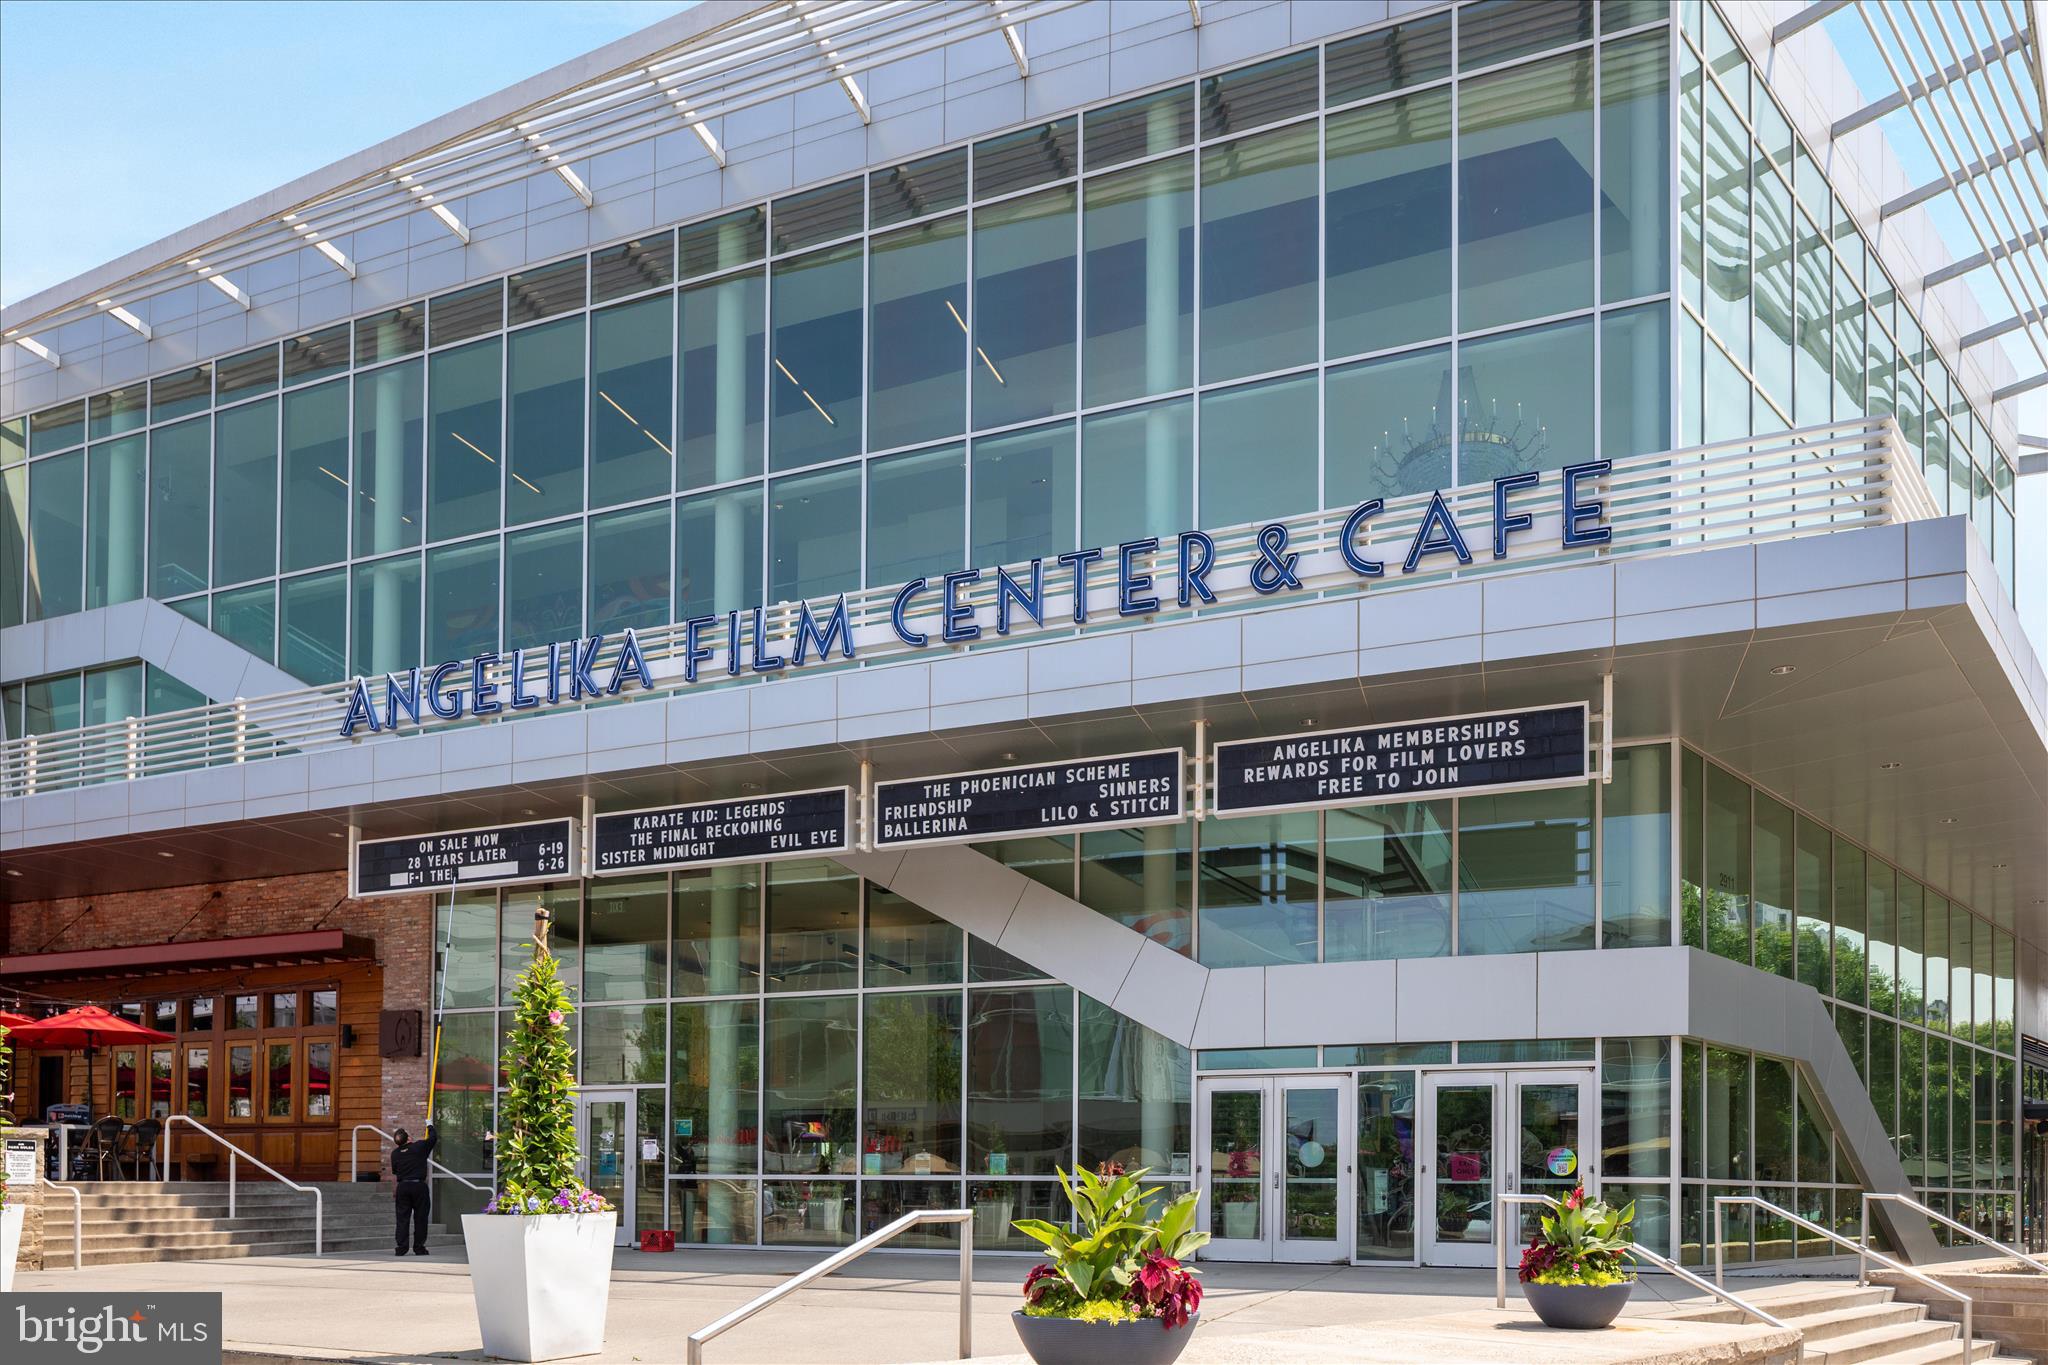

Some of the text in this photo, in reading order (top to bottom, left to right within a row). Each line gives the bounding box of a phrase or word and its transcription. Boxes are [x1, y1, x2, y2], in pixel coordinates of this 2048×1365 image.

[340, 459, 1612, 736] ANGELIKA FILM CENTER & CAFE
[1273, 719, 1520, 761] ANGELIKA MEMBERSHIPS
[1243, 739, 1526, 784] REWARDS FOR FILM LOVERS
[923, 763, 1131, 799] THE PHOENICIAN SCHEME
[1099, 776, 1171, 799] SINNERS
[1317, 766, 1460, 796] FREE TO JOIN
[634, 801, 785, 830] KARATE KID: LEGENDS
[884, 798, 973, 821] FRIENDSHIP
[1041, 796, 1170, 823] LILO & STITCH
[630, 818, 783, 847] THE FINAL RECKONING
[884, 816, 968, 838] BALLERINA
[419, 833, 499, 854] ON SALE NOW
[539, 842, 564, 856] 6-19
[770, 829, 838, 849] EVIL EYE
[408, 848, 507, 870] 28 YEARS LATER
[538, 857, 565, 872] 6-26
[601, 841, 716, 865] SISTER MIDNIGHT
[1719, 871, 1735, 889] 2911
